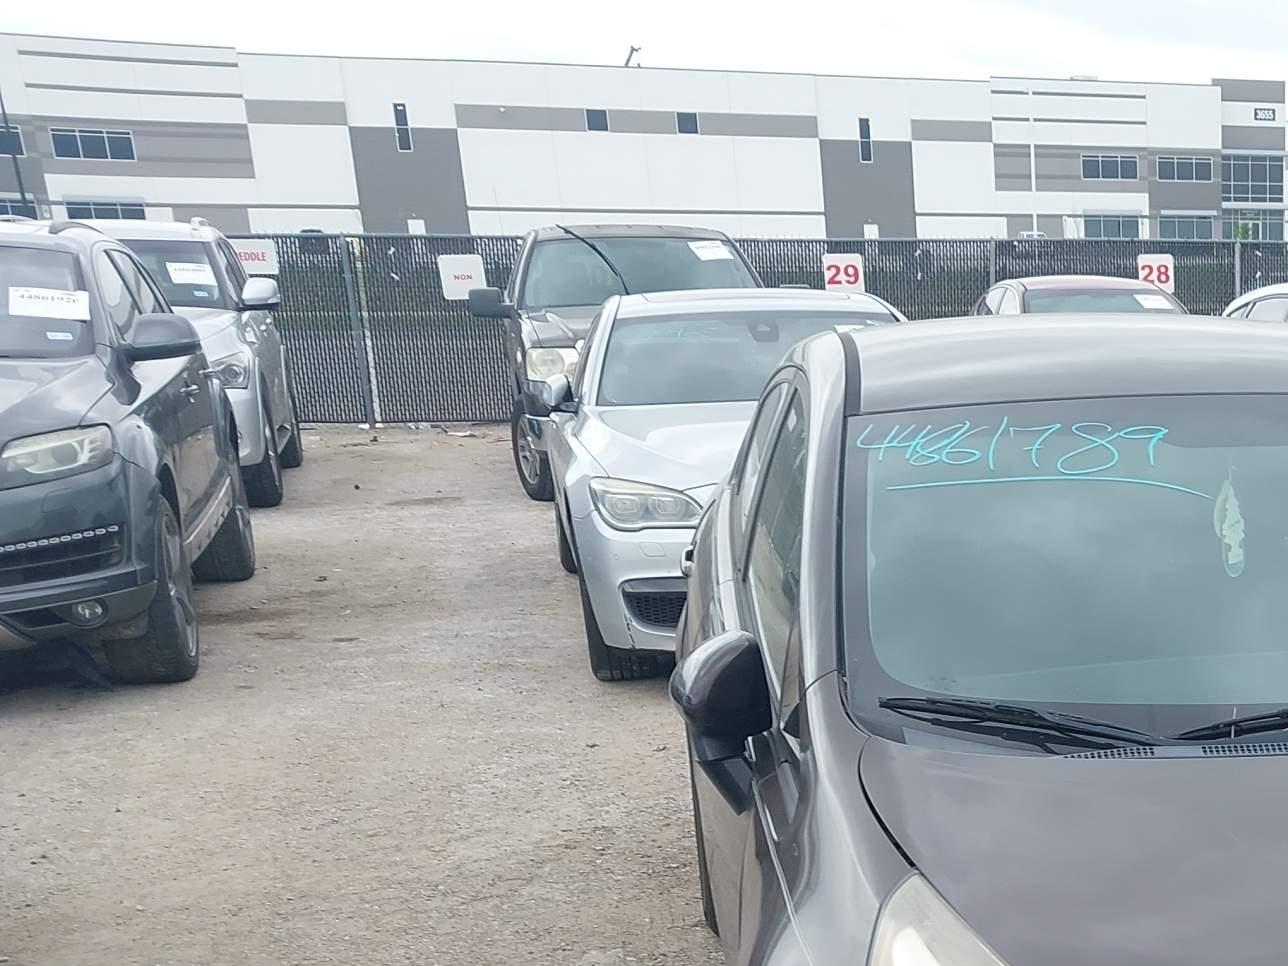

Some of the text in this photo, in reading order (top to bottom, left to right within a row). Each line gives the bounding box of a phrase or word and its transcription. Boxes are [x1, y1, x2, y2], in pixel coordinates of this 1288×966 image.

[240, 251, 267, 261] EDDLE
[826, 264, 860, 285] 29
[1140, 264, 1170, 284] 28
[856, 416, 1169, 474] 44861789
